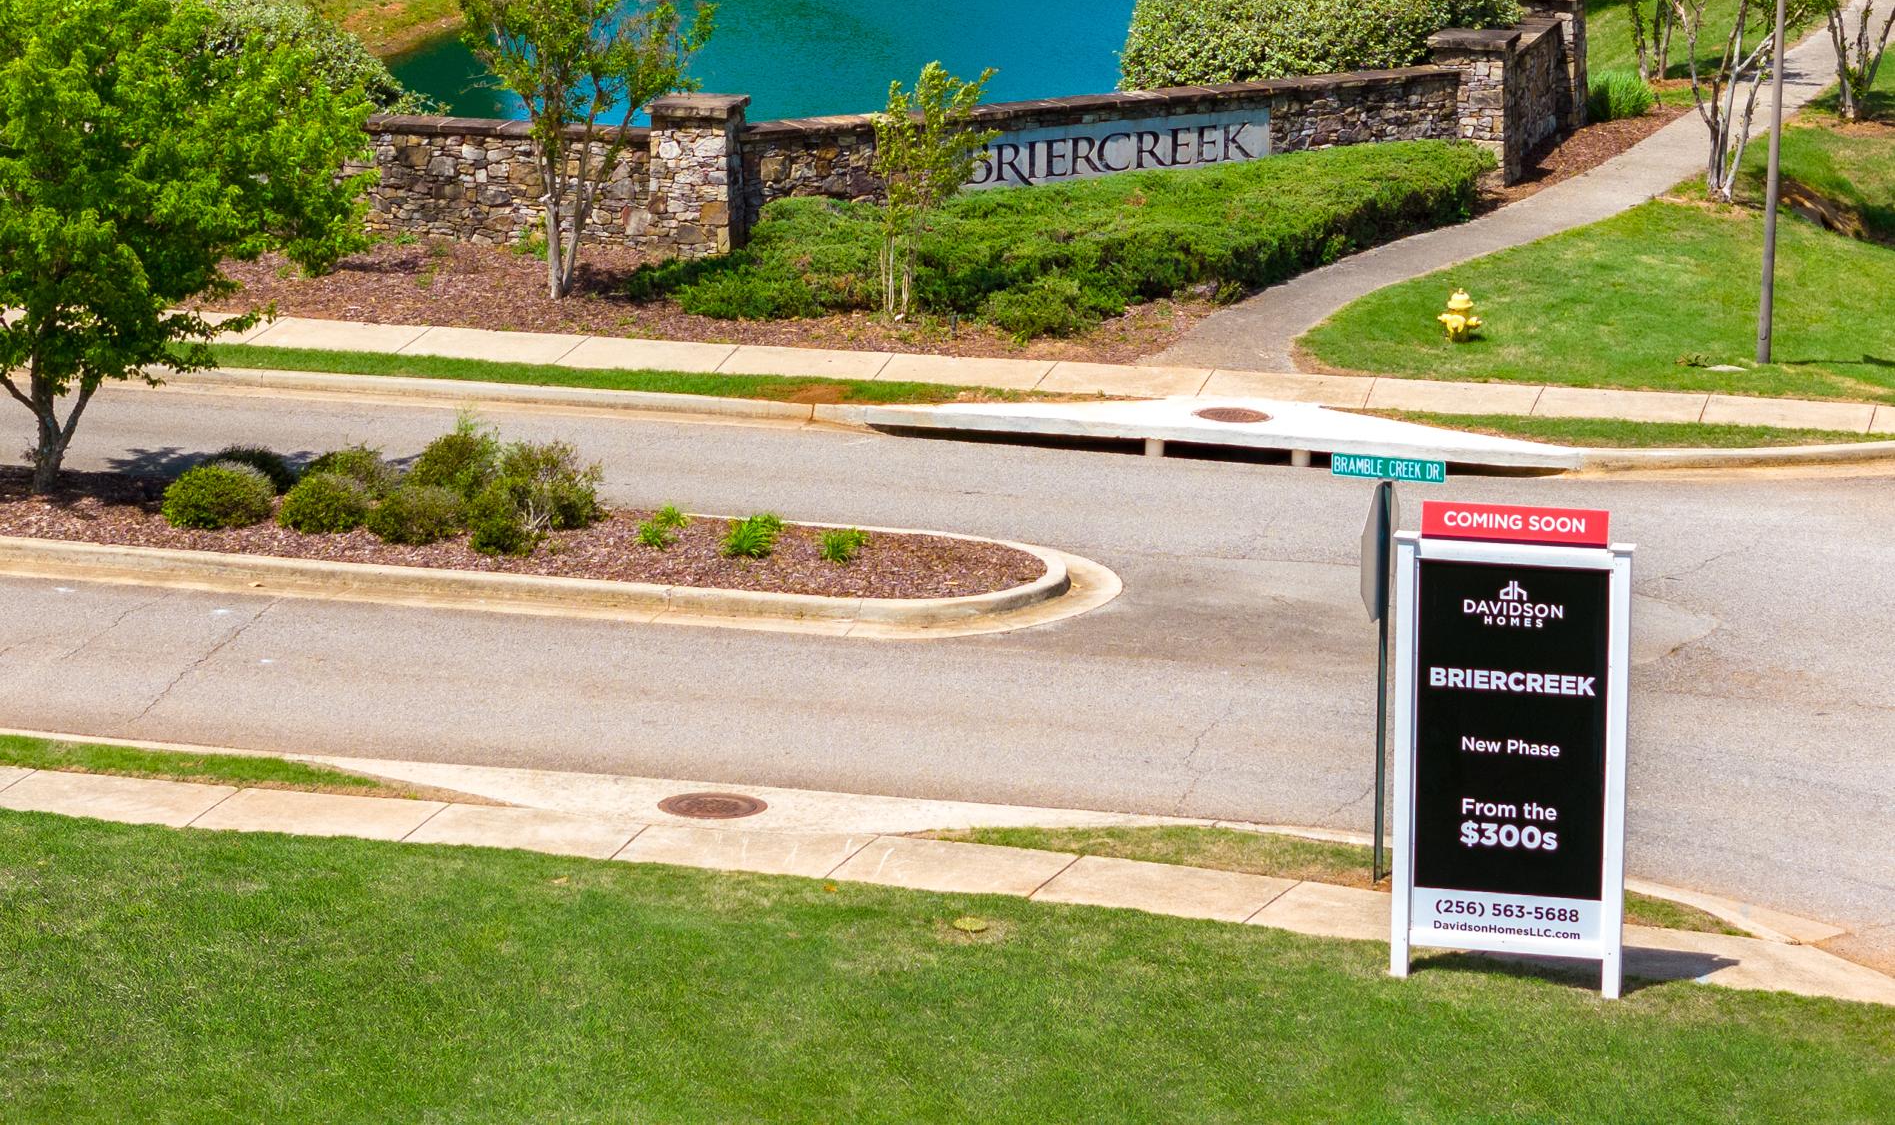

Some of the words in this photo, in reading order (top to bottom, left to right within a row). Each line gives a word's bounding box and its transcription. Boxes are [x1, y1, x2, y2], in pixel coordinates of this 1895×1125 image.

[1333, 455, 1383, 476] BRAMBLE
[1388, 460, 1422, 479] CREEK
[1443, 510, 1523, 530] COMING
[1528, 515, 1586, 533] SOON
[1463, 599, 1564, 619] DAVIDSON
[1484, 615, 1544, 628] HOMES
[1429, 666, 1596, 696] BRIERCREEK
[1461, 735, 1501, 753] New
[1507, 739, 1561, 757] Phase
[1461, 798, 1516, 818] From
[1523, 802, 1557, 821] the
[1460, 820, 1558, 851] $300s
[1435, 899, 1485, 917] (256)
[1491, 903, 1580, 923] 563-5688
[1433, 920, 1581, 940] DavidsonHomesLLC.com
